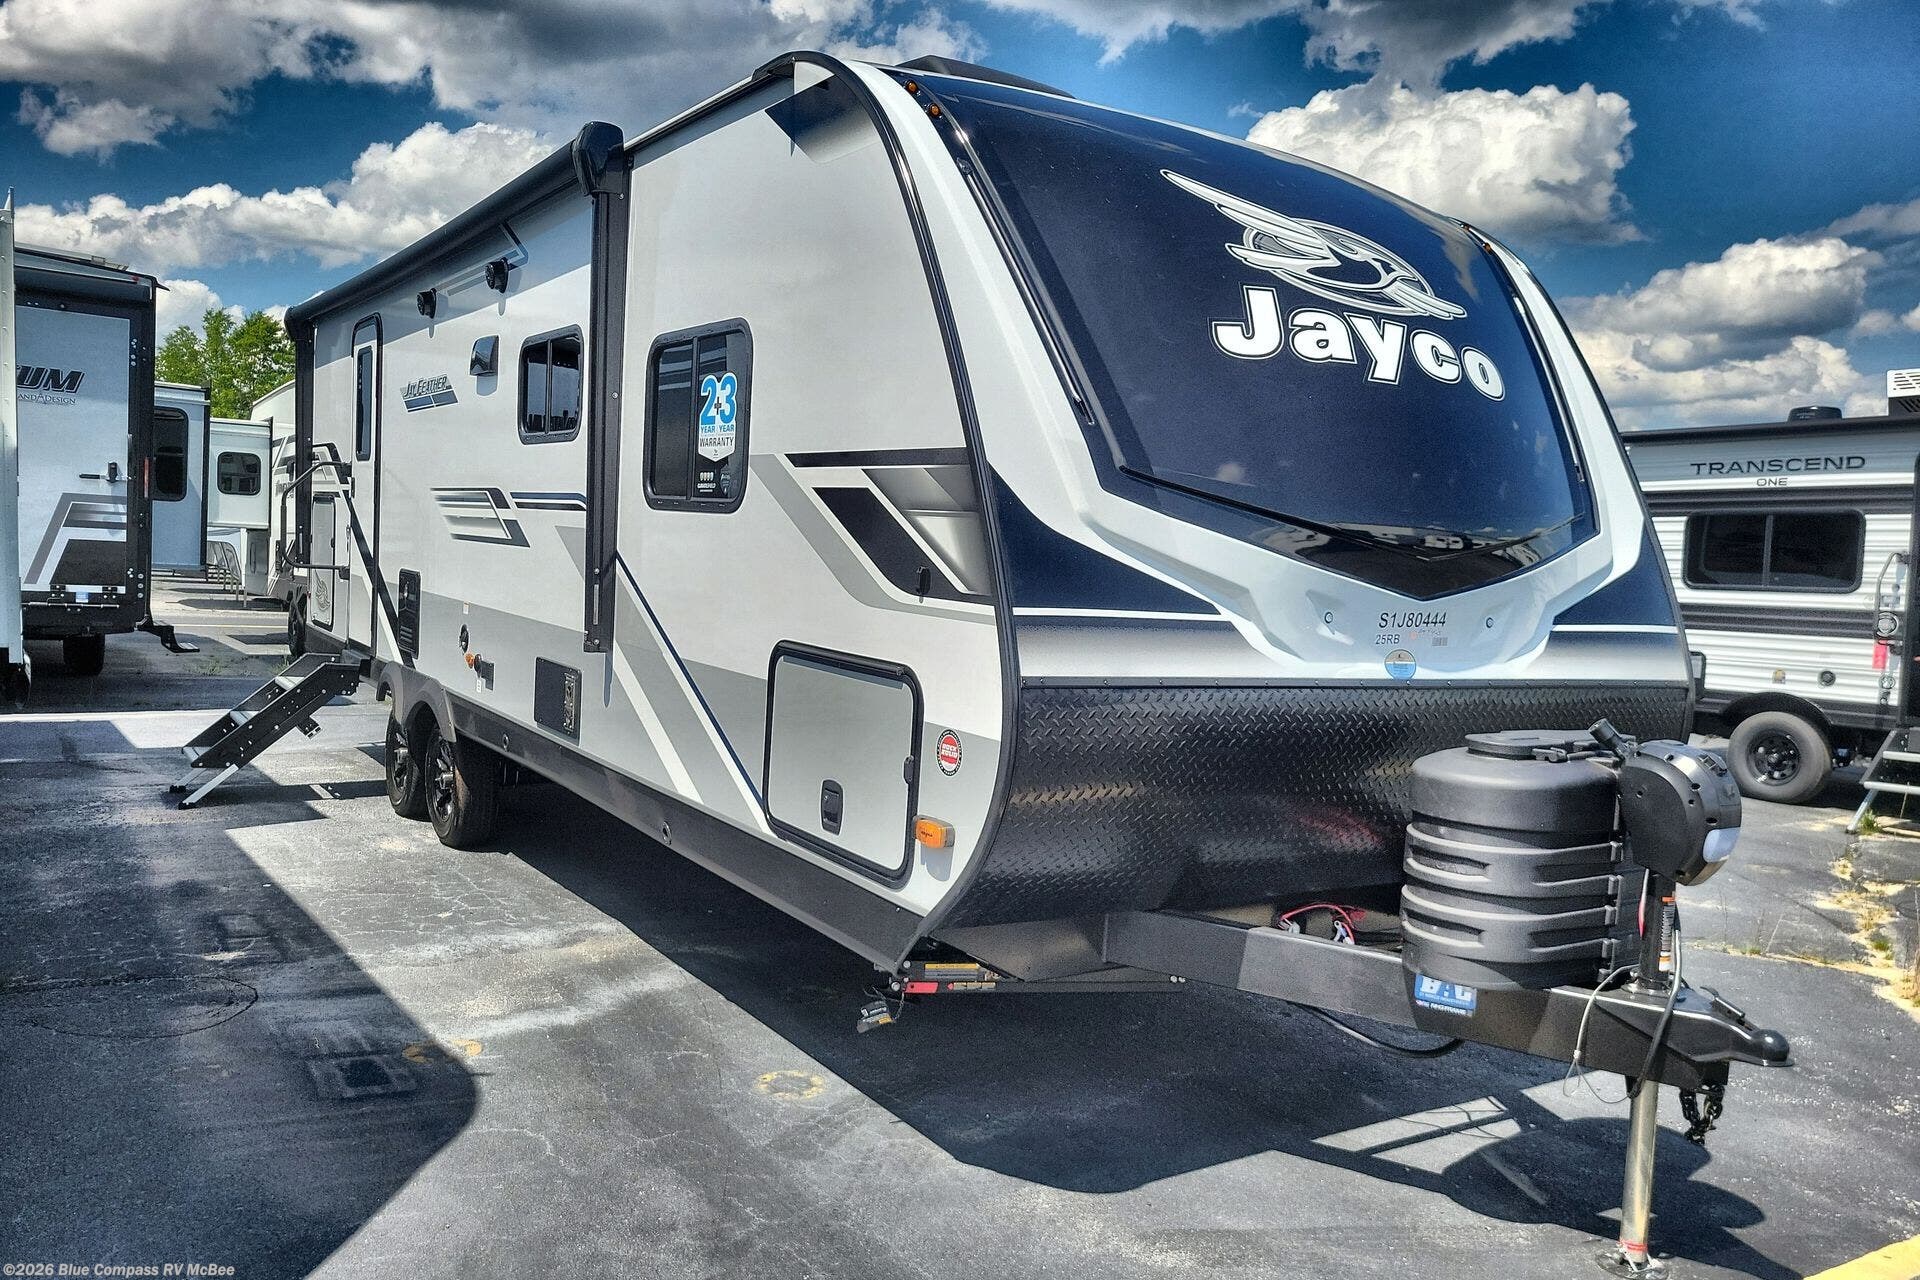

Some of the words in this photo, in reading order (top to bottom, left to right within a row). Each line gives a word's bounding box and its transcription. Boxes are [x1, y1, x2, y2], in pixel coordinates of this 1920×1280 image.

[1211, 286, 1506, 401] Jayco
[16, 365, 86, 393] UM
[701, 425, 716, 434] YEAR
[719, 424, 734, 433] YEAR
[700, 437, 734, 448] WARRANTY
[1690, 456, 1866, 475] TRANSCEND
[1756, 477, 1788, 487] ONE
[1378, 612, 1447, 628] S1J80444
[1375, 634, 1401, 645] 25RB
